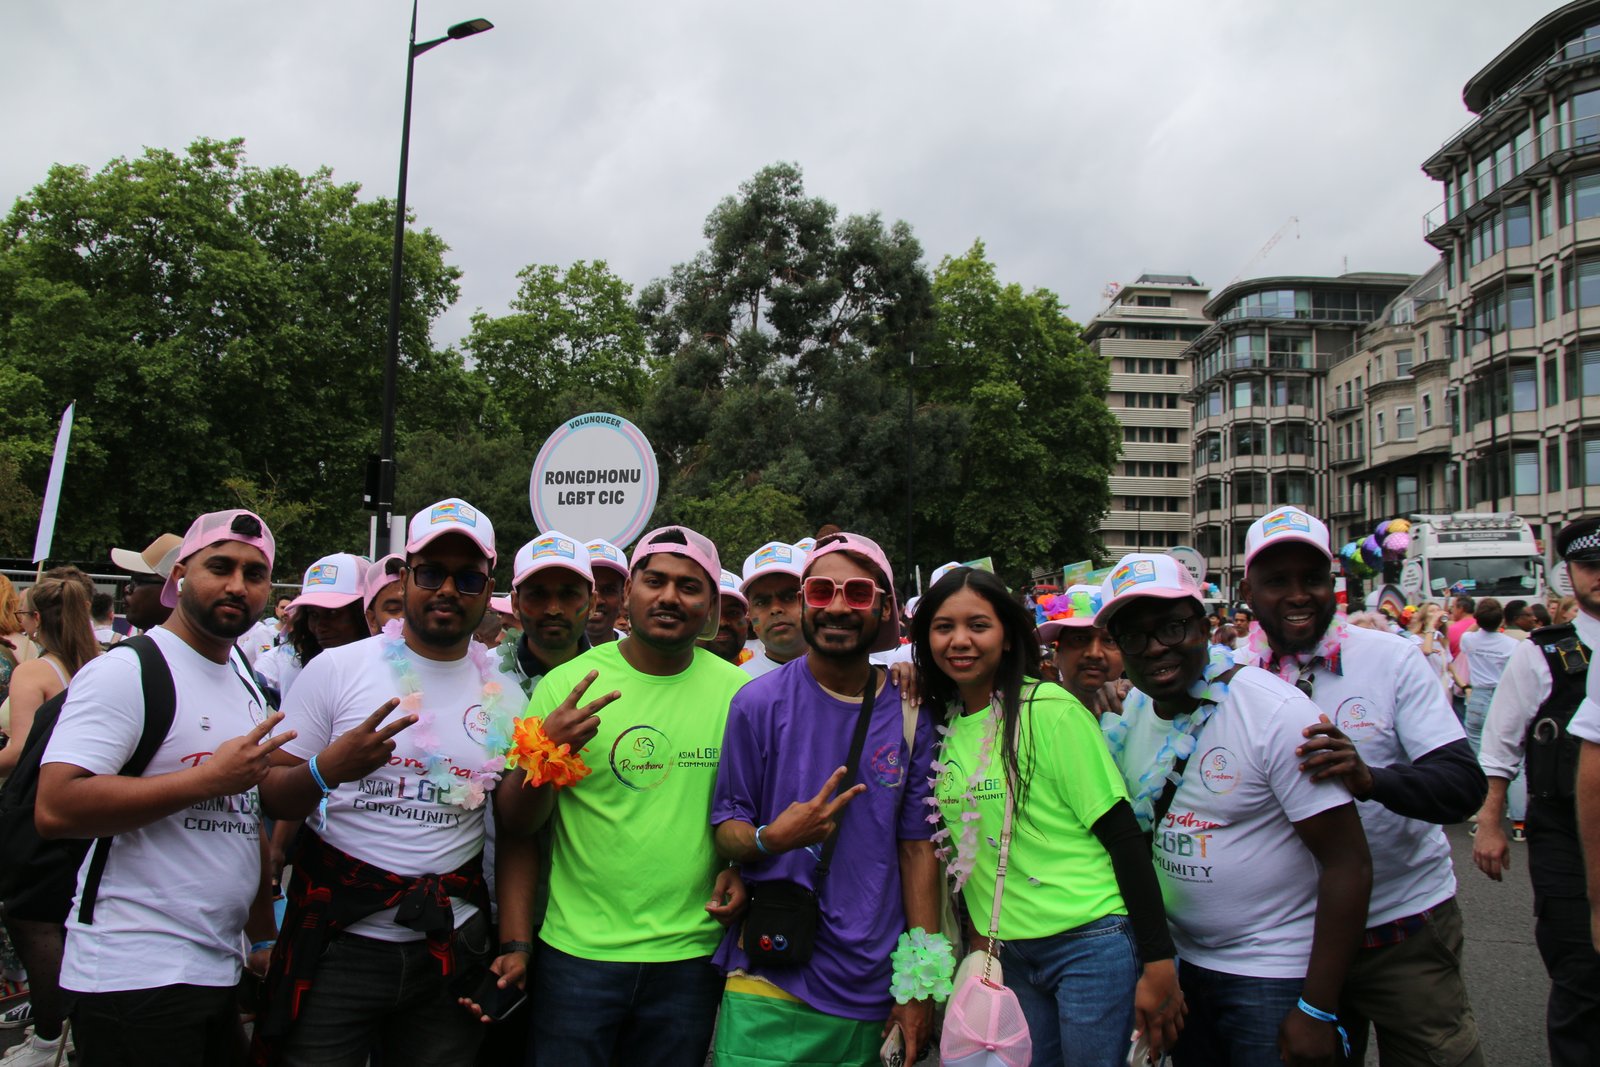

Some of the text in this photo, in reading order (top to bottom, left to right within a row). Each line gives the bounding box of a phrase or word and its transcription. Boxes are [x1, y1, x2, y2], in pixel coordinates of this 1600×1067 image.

[569, 415, 621, 429] VOLUNQUEER
[545, 469, 641, 485] RONGDHONU
[558, 490, 625, 505] LGBT CIC
[678, 747, 720, 759] ASIAN LGB
[358, 776, 452, 806] ASIAN LGB
[977, 778, 1001, 791] LGB
[353, 798, 462, 825] COMMUNITY
